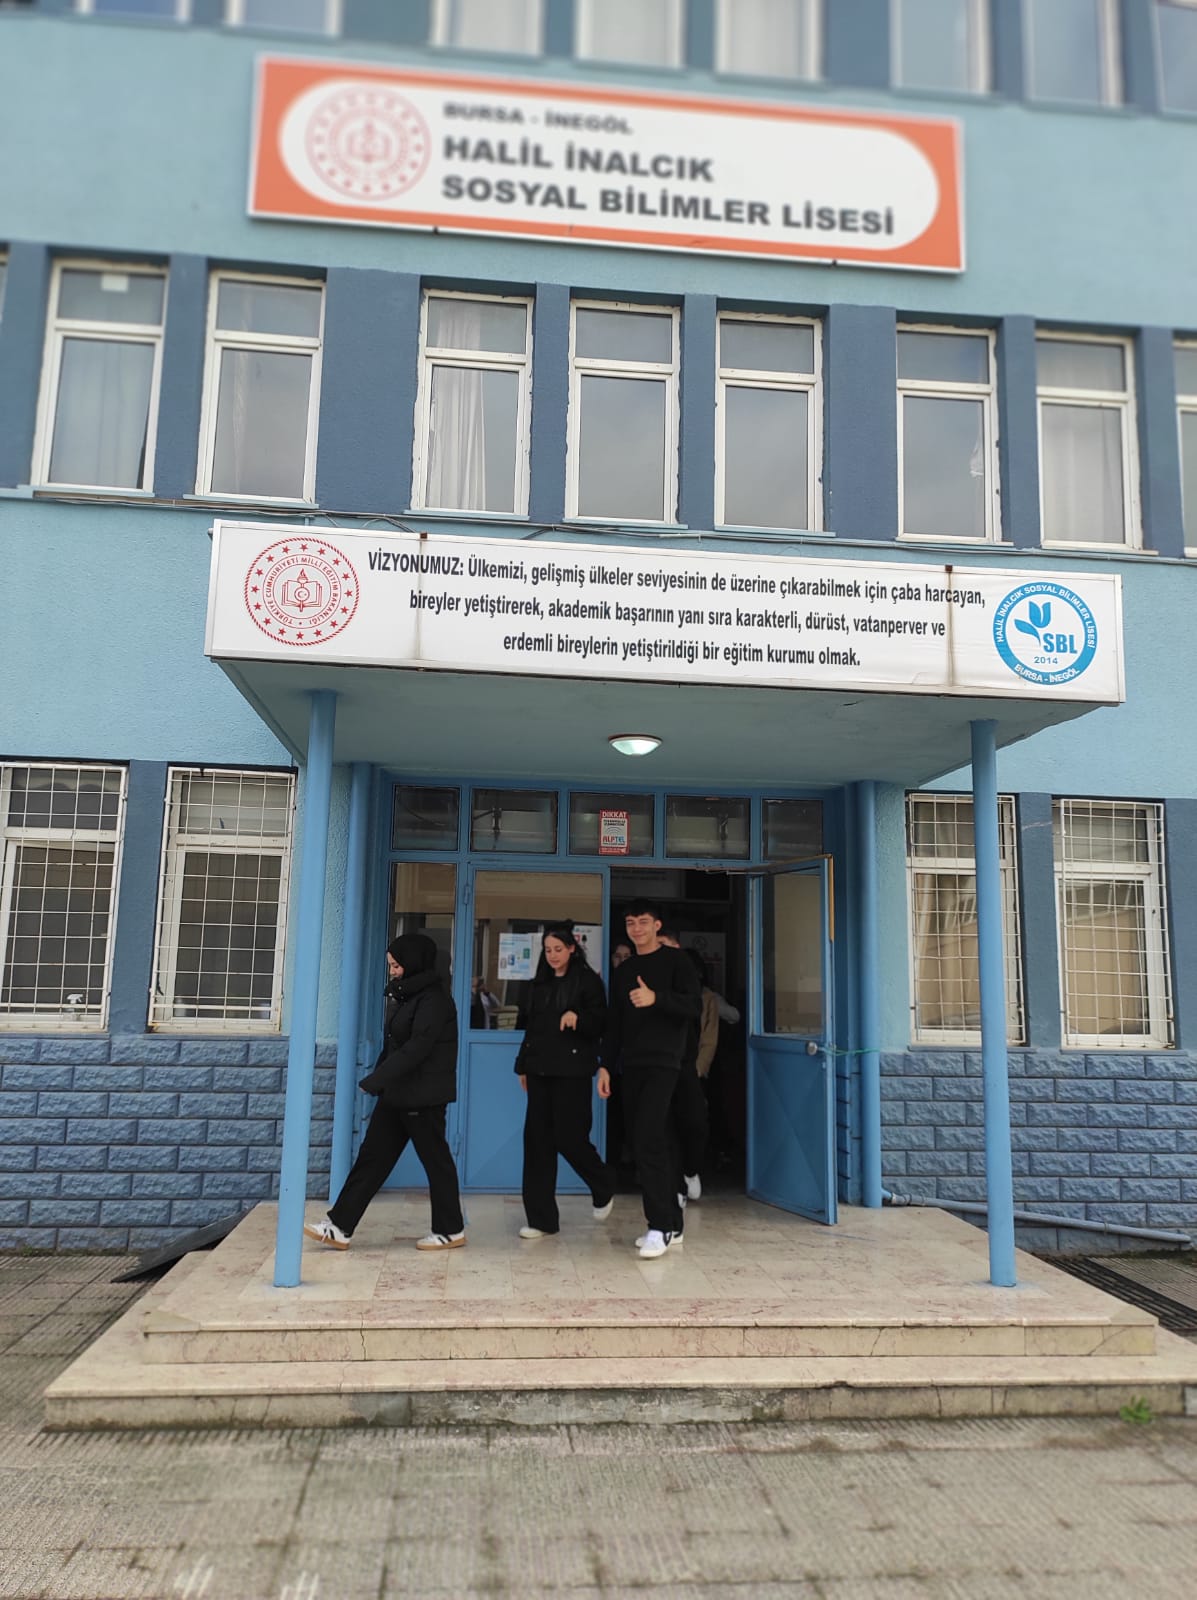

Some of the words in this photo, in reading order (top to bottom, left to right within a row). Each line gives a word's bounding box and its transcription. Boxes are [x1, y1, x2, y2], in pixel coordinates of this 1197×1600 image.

[443, 102, 525, 125] BURSA
[545, 109, 633, 135] İNEGÖL
[443, 136, 553, 169] HALİL
[565, 140, 714, 182] İNALCIK
[442, 175, 588, 211] SOSYAL
[600, 186, 771, 226] BİLİMLER
[781, 199, 894, 236] LİSESİ
[368, 549, 464, 576] VİZYONUMUZ:
[468, 553, 528, 585] Ülkemizi,
[531, 562, 586, 590] gelişmiş
[589, 565, 634, 588] ülkeler
[636, 569, 707, 594] seviyesinin
[711, 573, 727, 591] de
[730, 574, 776, 595] üzerine
[779, 577, 861, 601] çıkarabilmek
[865, 580, 887, 603] için
[891, 582, 921, 605] çaba
[925, 584, 985, 609] harcayan,
[409, 589, 462, 615] bireyler
[463, 593, 544, 621] yetiştirerek,
[548, 598, 611, 620] akademik
[615, 601, 674, 627] başarının
[677, 608, 704, 629] yanı
[708, 609, 732, 627] sıra
[736, 607, 802, 634] karakterli,
[805, 611, 850, 635] dürüst,
[853, 616, 928, 639] vatanperver
[931, 621, 946, 636] ve
[995, 619, 1005, 643] HALİL
[1024, 584, 1057, 594] SOSYAL
[1058, 590, 1090, 620] BİLİMLER
[503, 631, 553, 653] erdemli
[557, 634, 618, 659] bireylerin
[621, 638, 699, 664] yetiştirildiği
[702, 640, 720, 660] bir
[723, 642, 763, 666] eğitim
[767, 644, 815, 665] kurumu
[818, 646, 861, 667] olmak.
[1034, 656, 1059, 664] 2014
[1042, 632, 1078, 654] SBL
[1014, 663, 1043, 683] BURSA
[1049, 667, 1081, 683] İNEGÖL
